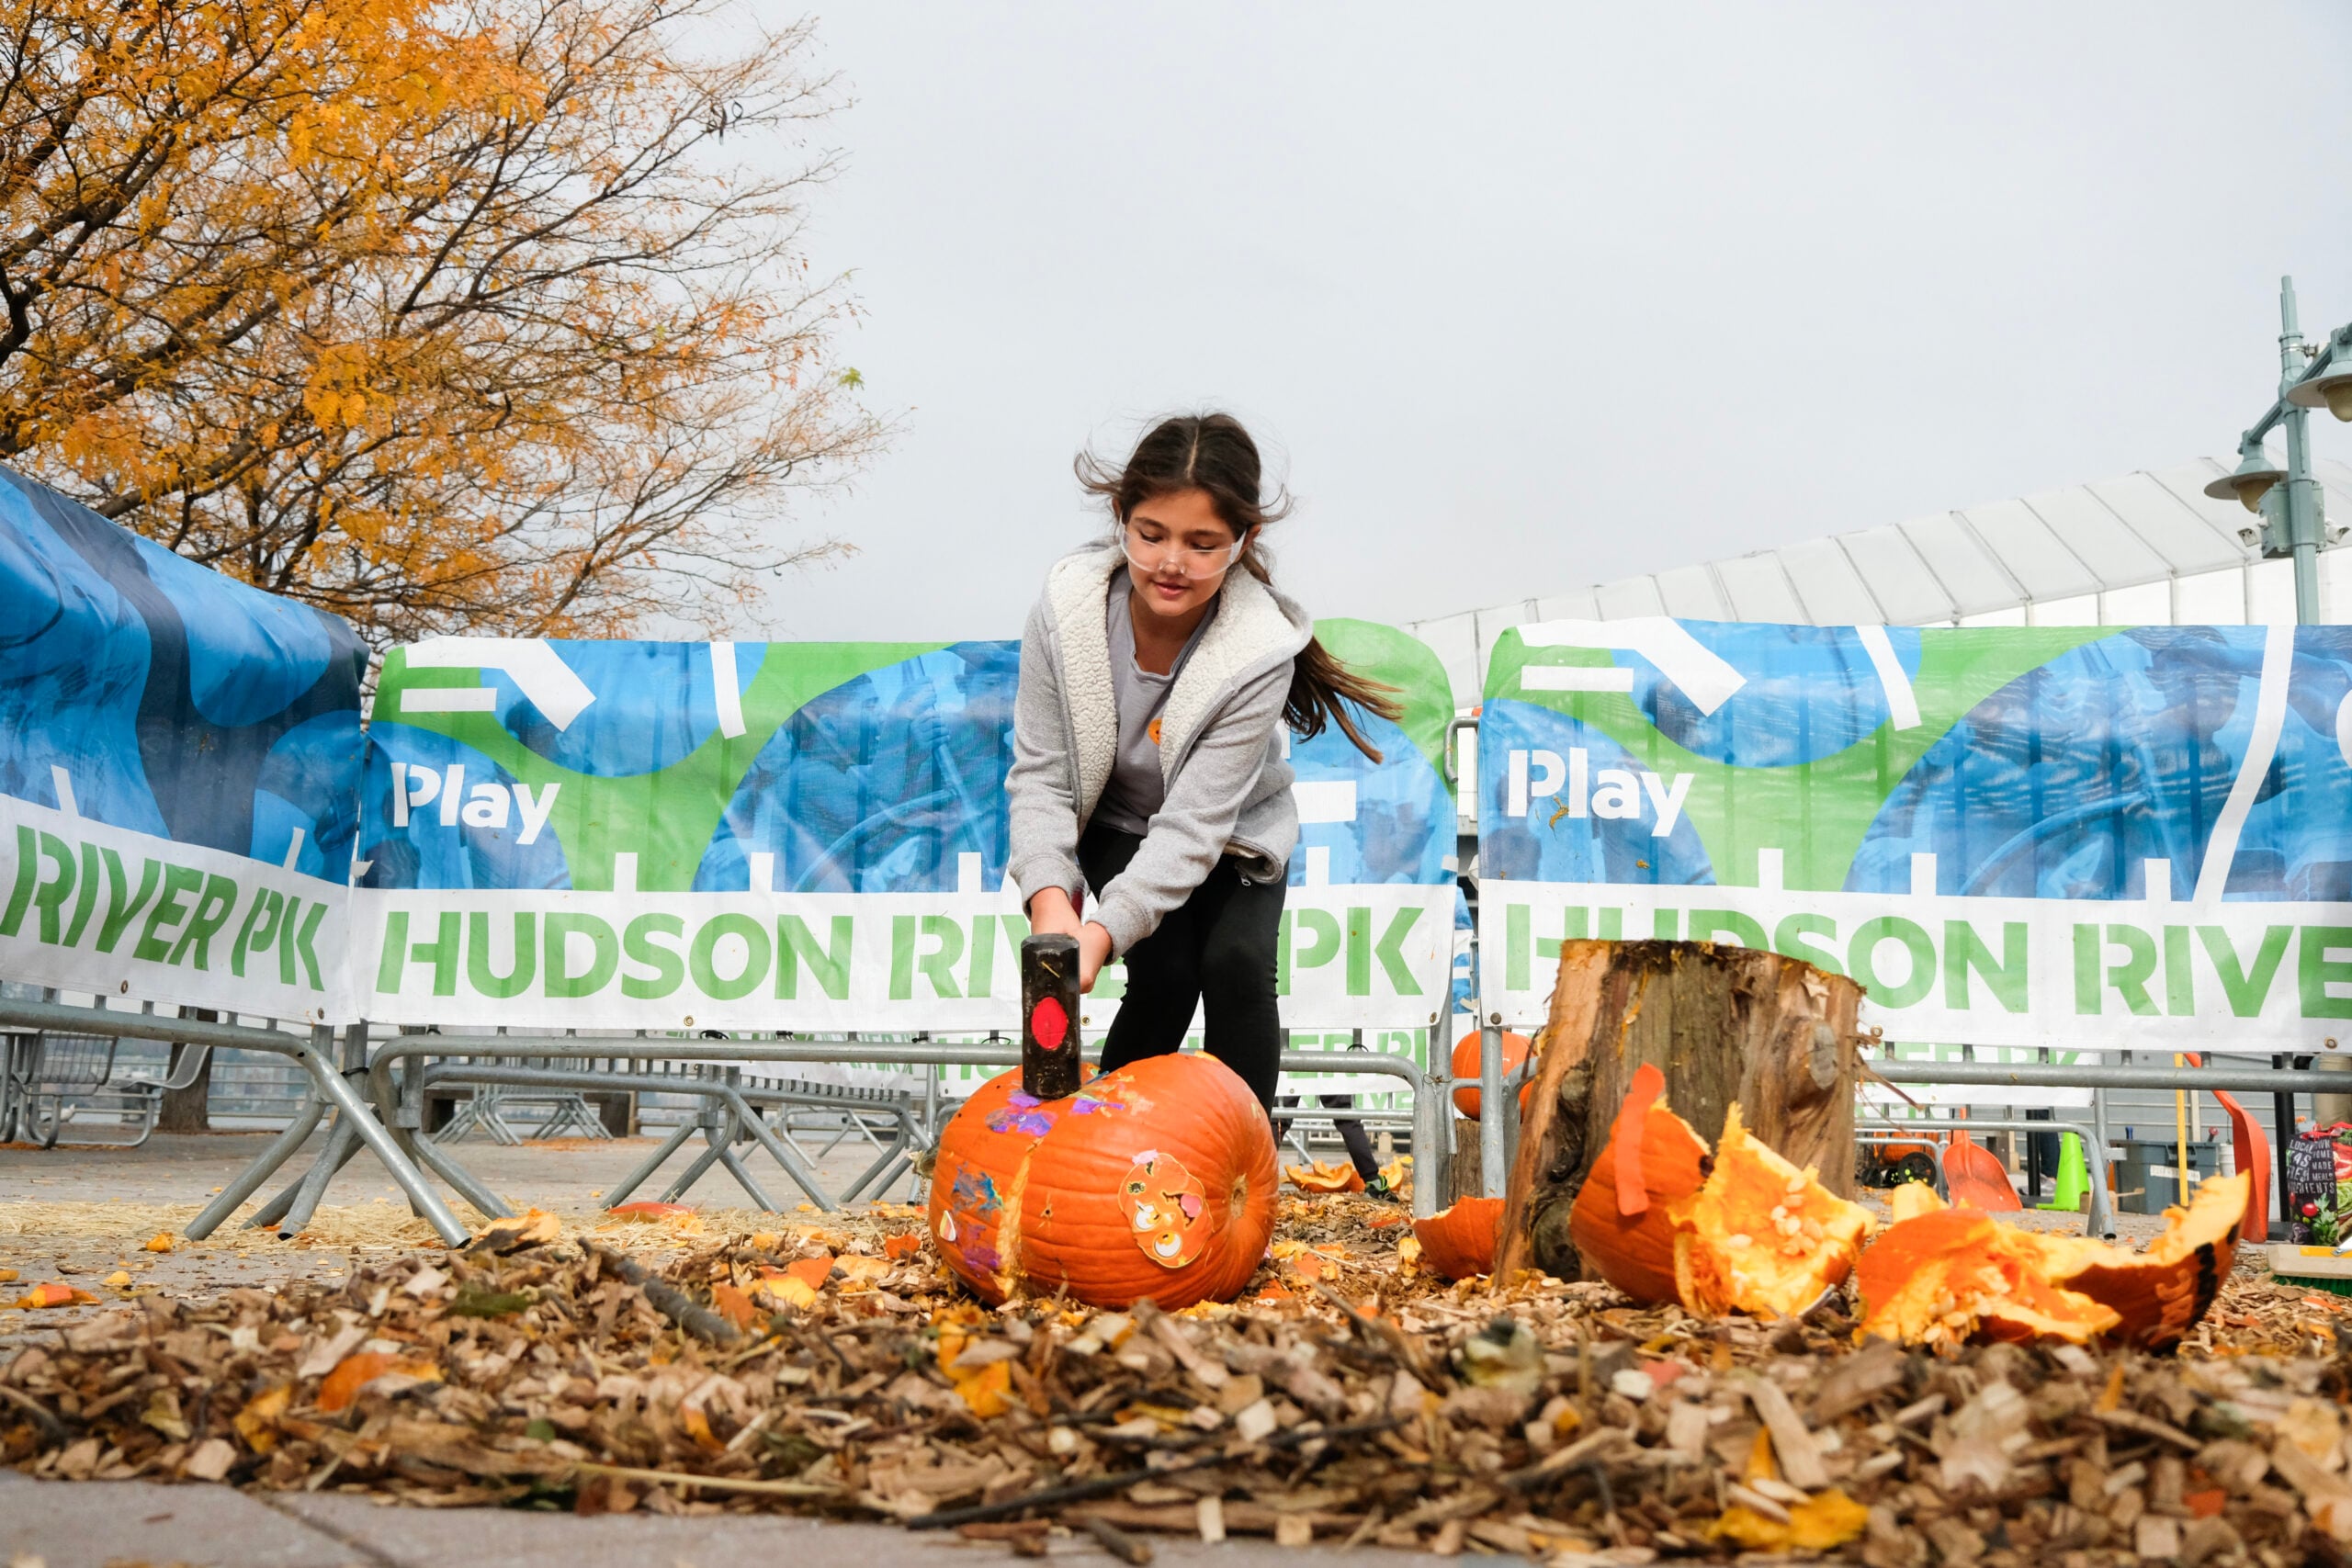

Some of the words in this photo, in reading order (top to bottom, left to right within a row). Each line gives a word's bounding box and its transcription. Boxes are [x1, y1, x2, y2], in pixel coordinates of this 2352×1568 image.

[390, 761, 562, 844] Play
[1508, 747, 1695, 837] Play
[0, 824, 238, 971] RIVER
[231, 886, 329, 991] PK
[377, 912, 854, 1000] HUDSON
[1275, 908, 1423, 996] PK
